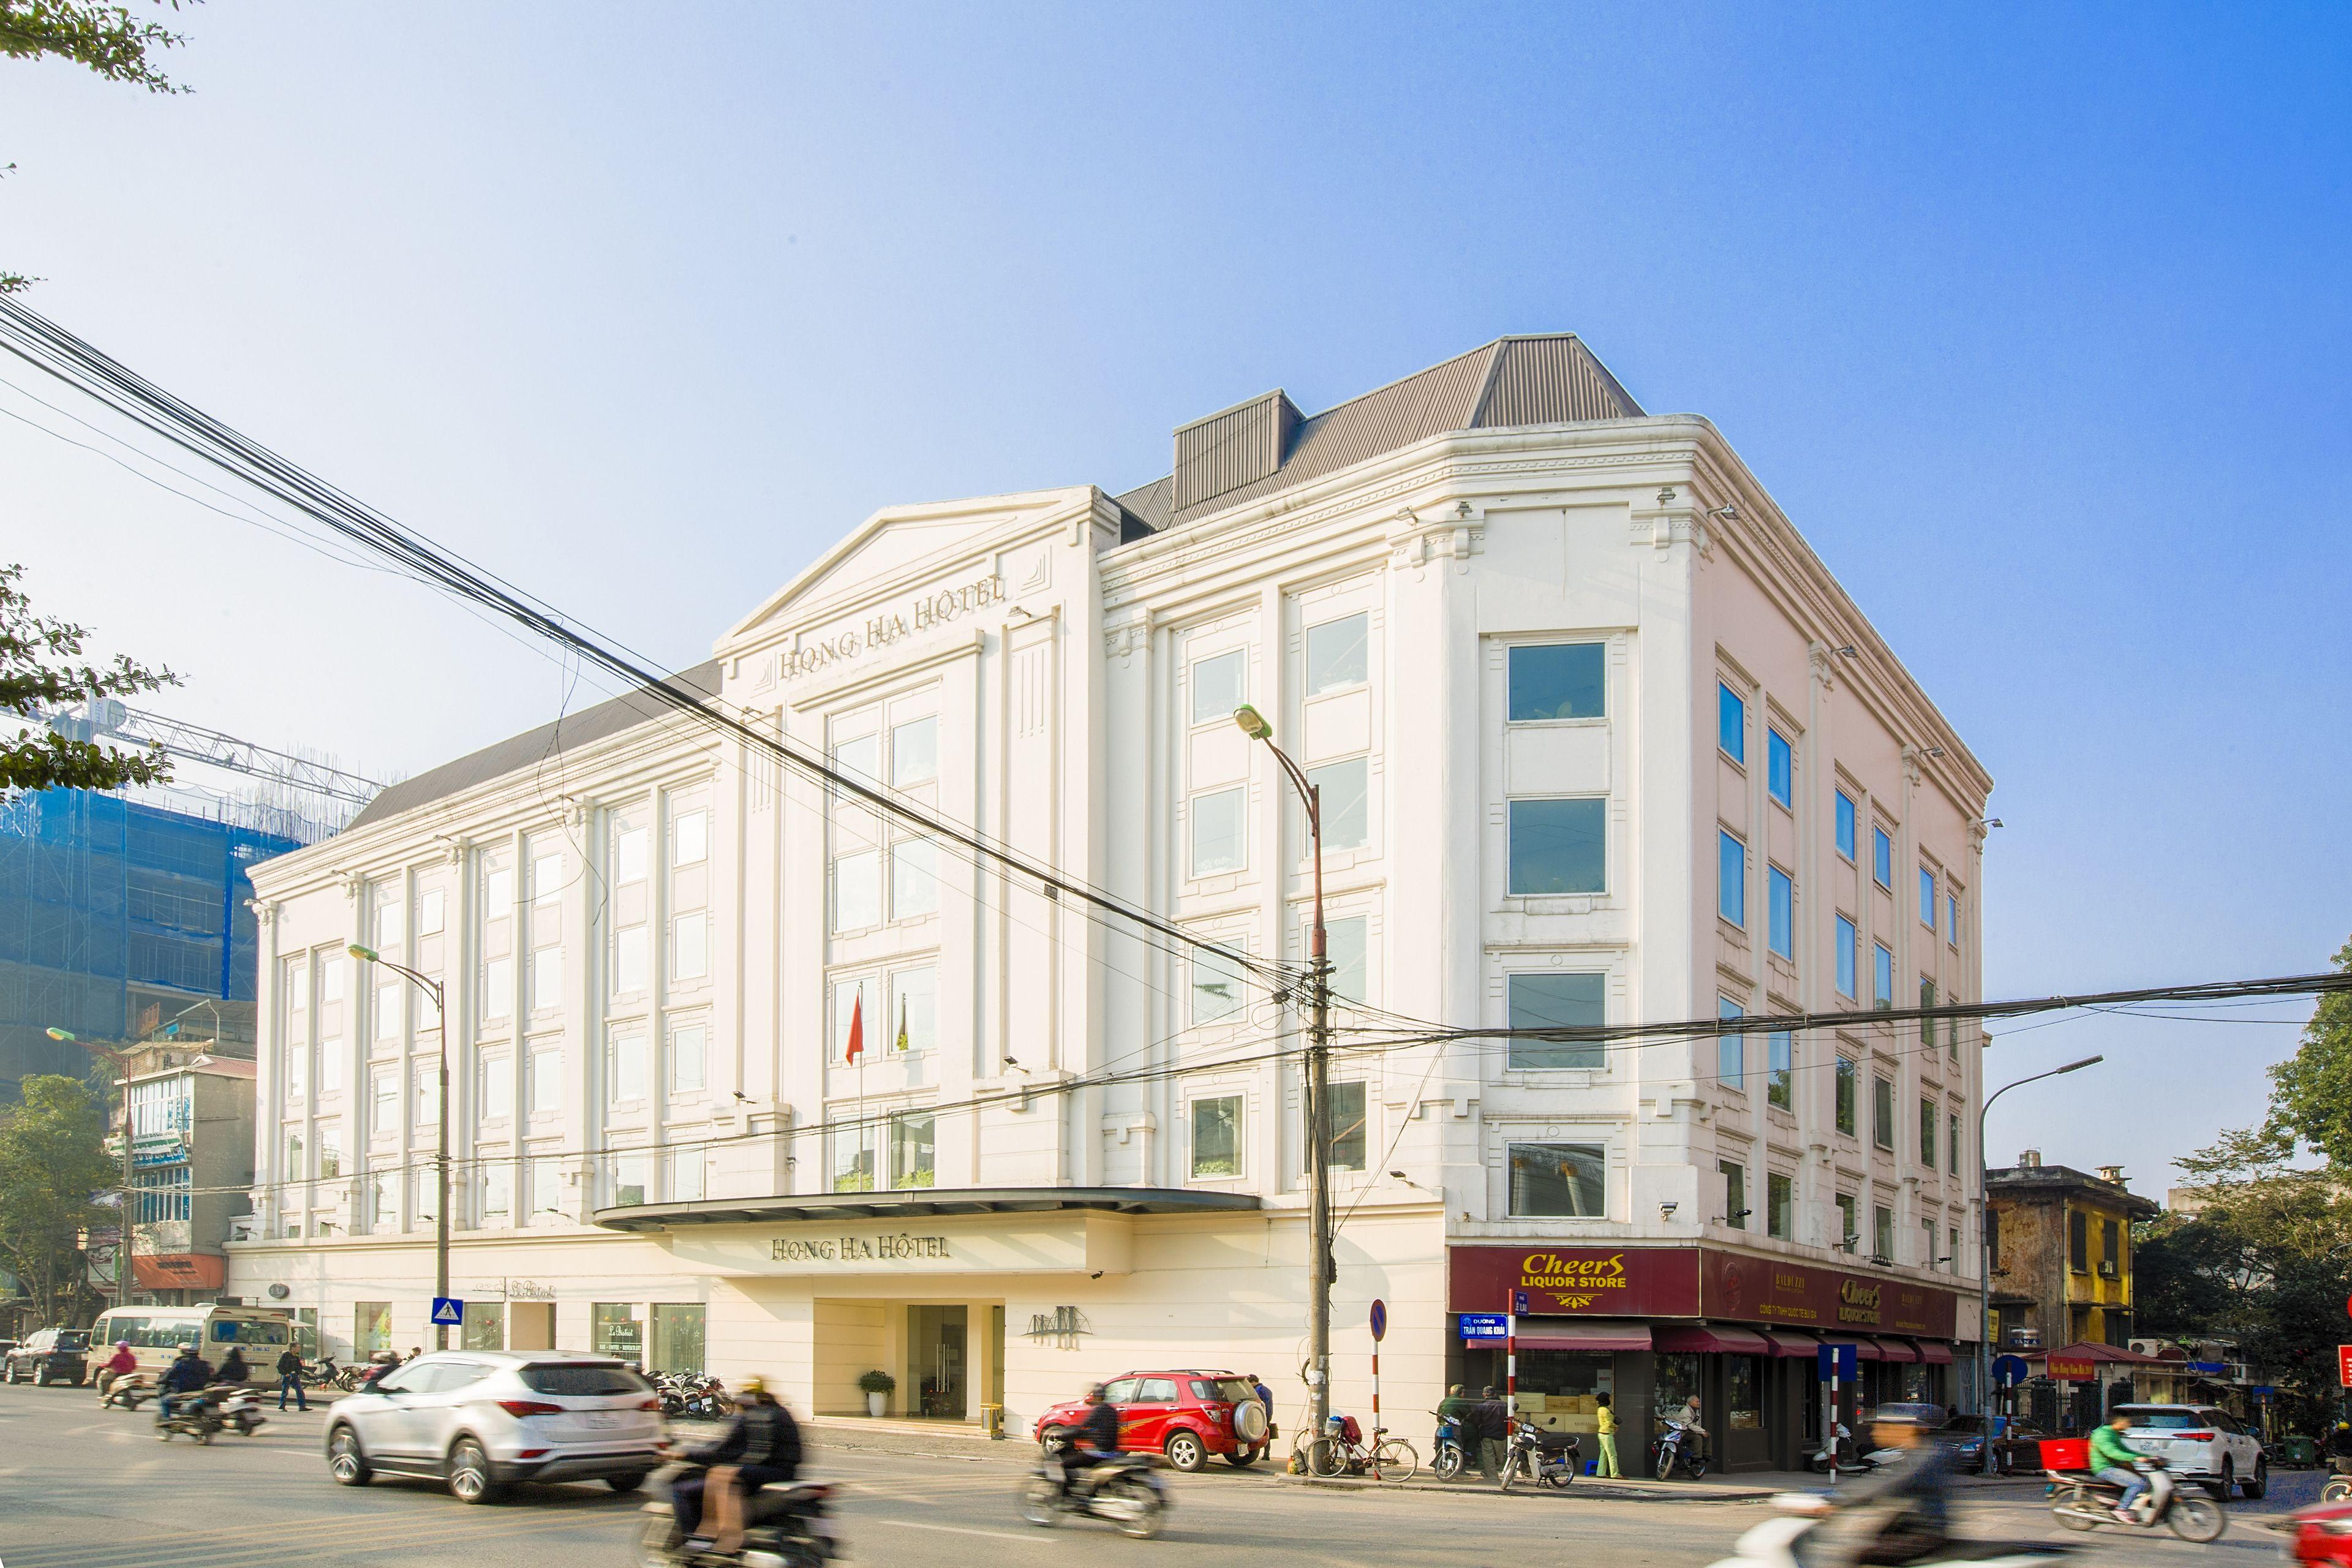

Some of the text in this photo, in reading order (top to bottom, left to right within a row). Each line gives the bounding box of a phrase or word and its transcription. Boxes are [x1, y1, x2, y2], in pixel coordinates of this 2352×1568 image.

[779, 573, 1006, 680] HONG HA HÔTEL
[771, 1233, 951, 1261] HONG HA HÔTEL
[1521, 1276, 1626, 1288] LIQUOR STORE
[1477, 1326, 1493, 1335] QUANG
